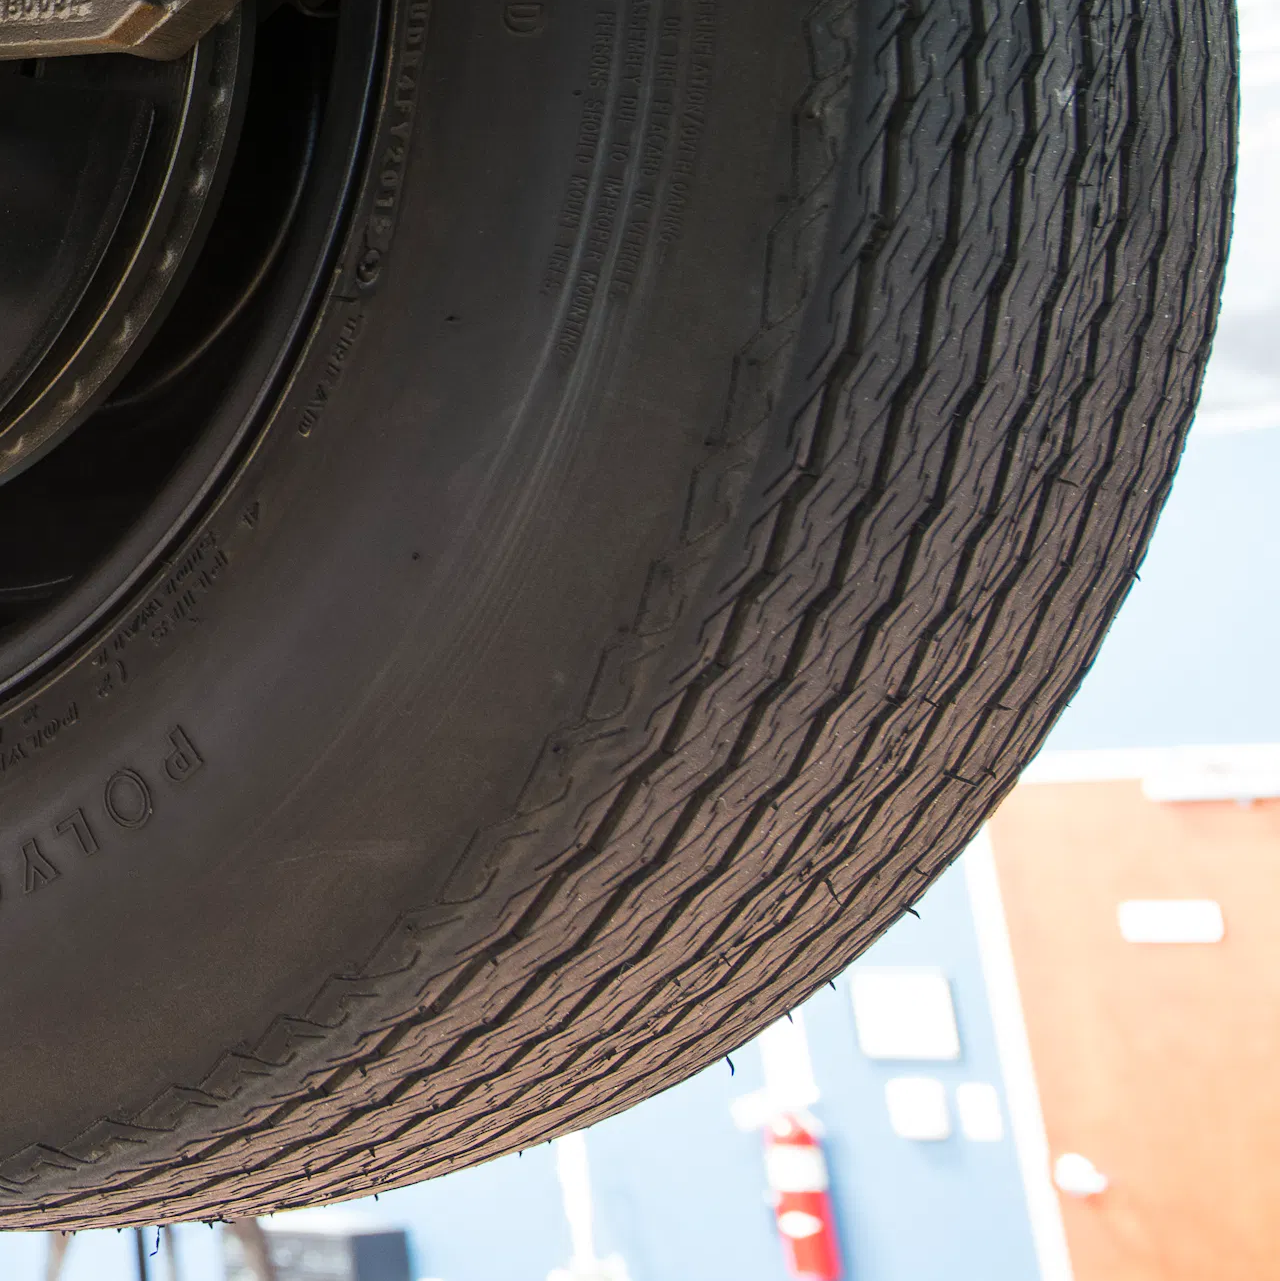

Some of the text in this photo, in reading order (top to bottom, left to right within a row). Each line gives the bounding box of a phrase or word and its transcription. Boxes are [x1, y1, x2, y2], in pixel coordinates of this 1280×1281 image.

[585, 11, 613, 89] PERSONS
[571, 97, 603, 166] SHOULD
[610, 142, 630, 165] TO
[558, 173, 589, 231] MOUNT
[584, 176, 624, 266] IMPROPER
[295, 315, 364, 440] TREAD
[146, 547, 230, 649] PLIES
